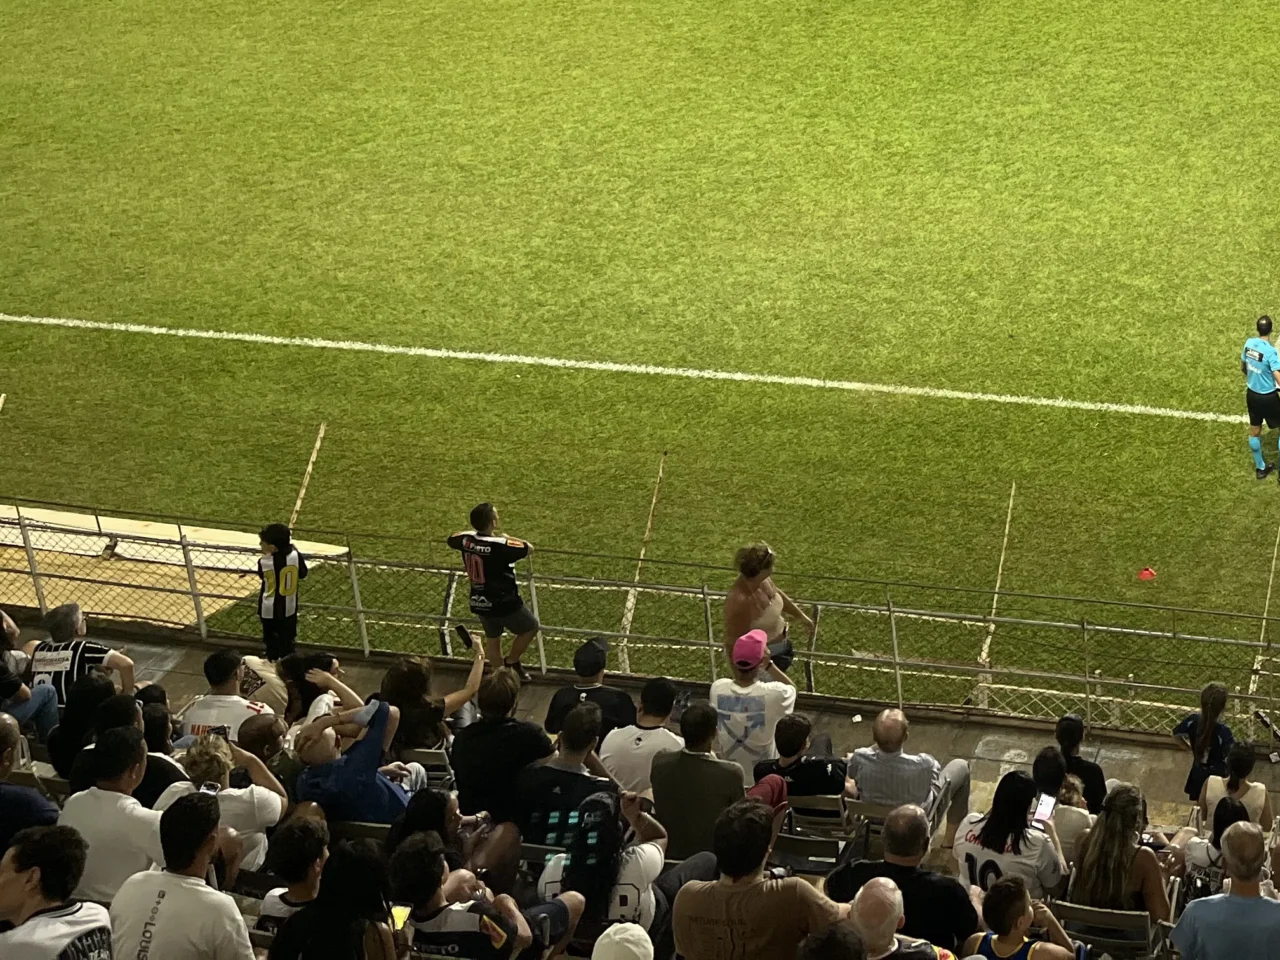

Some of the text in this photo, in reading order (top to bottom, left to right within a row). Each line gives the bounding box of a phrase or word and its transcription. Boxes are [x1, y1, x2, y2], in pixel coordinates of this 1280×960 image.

[264, 565, 298, 597] 10
[463, 551, 486, 584] 10
[964, 852, 1004, 892] 10
